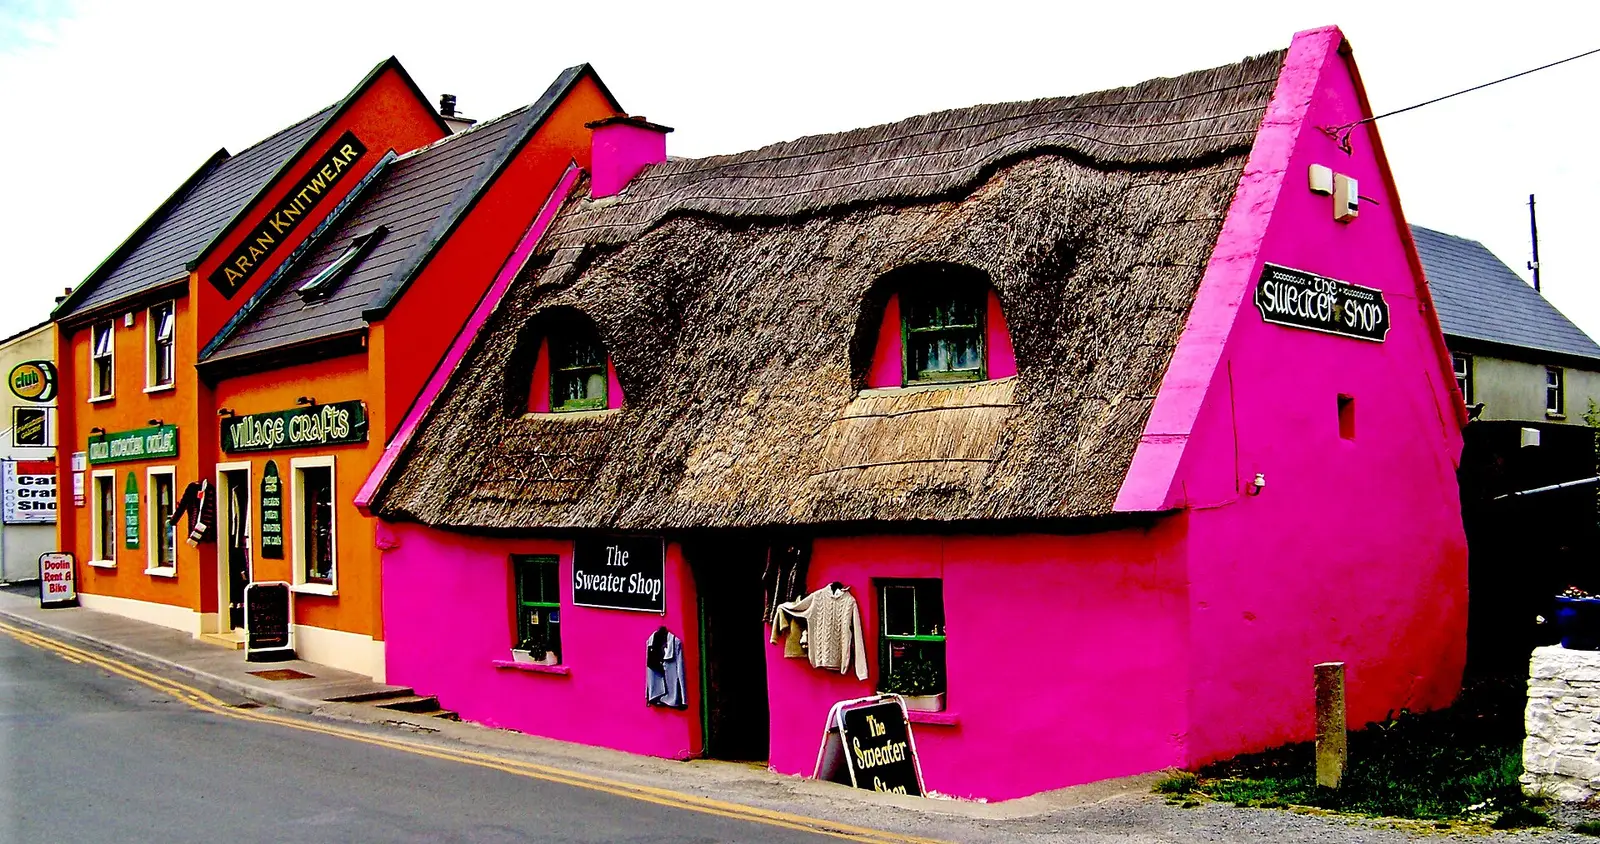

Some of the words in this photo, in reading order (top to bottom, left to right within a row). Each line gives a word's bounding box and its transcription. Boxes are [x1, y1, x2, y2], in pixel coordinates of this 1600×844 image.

[224, 231, 274, 286] ARAN
[269, 144, 358, 234] KNITWEAR
[15, 370, 39, 388] club
[44, 561, 70, 570] Doolin
[606, 545, 629, 567] The
[44, 572, 63, 581] Rent
[65, 571, 72, 581] A
[575, 570, 626, 593] Sweater
[628, 572, 661, 601] Shop
[49, 583, 67, 594] Bike
[866, 714, 886, 737] The
[853, 736, 906, 769] Sweater
